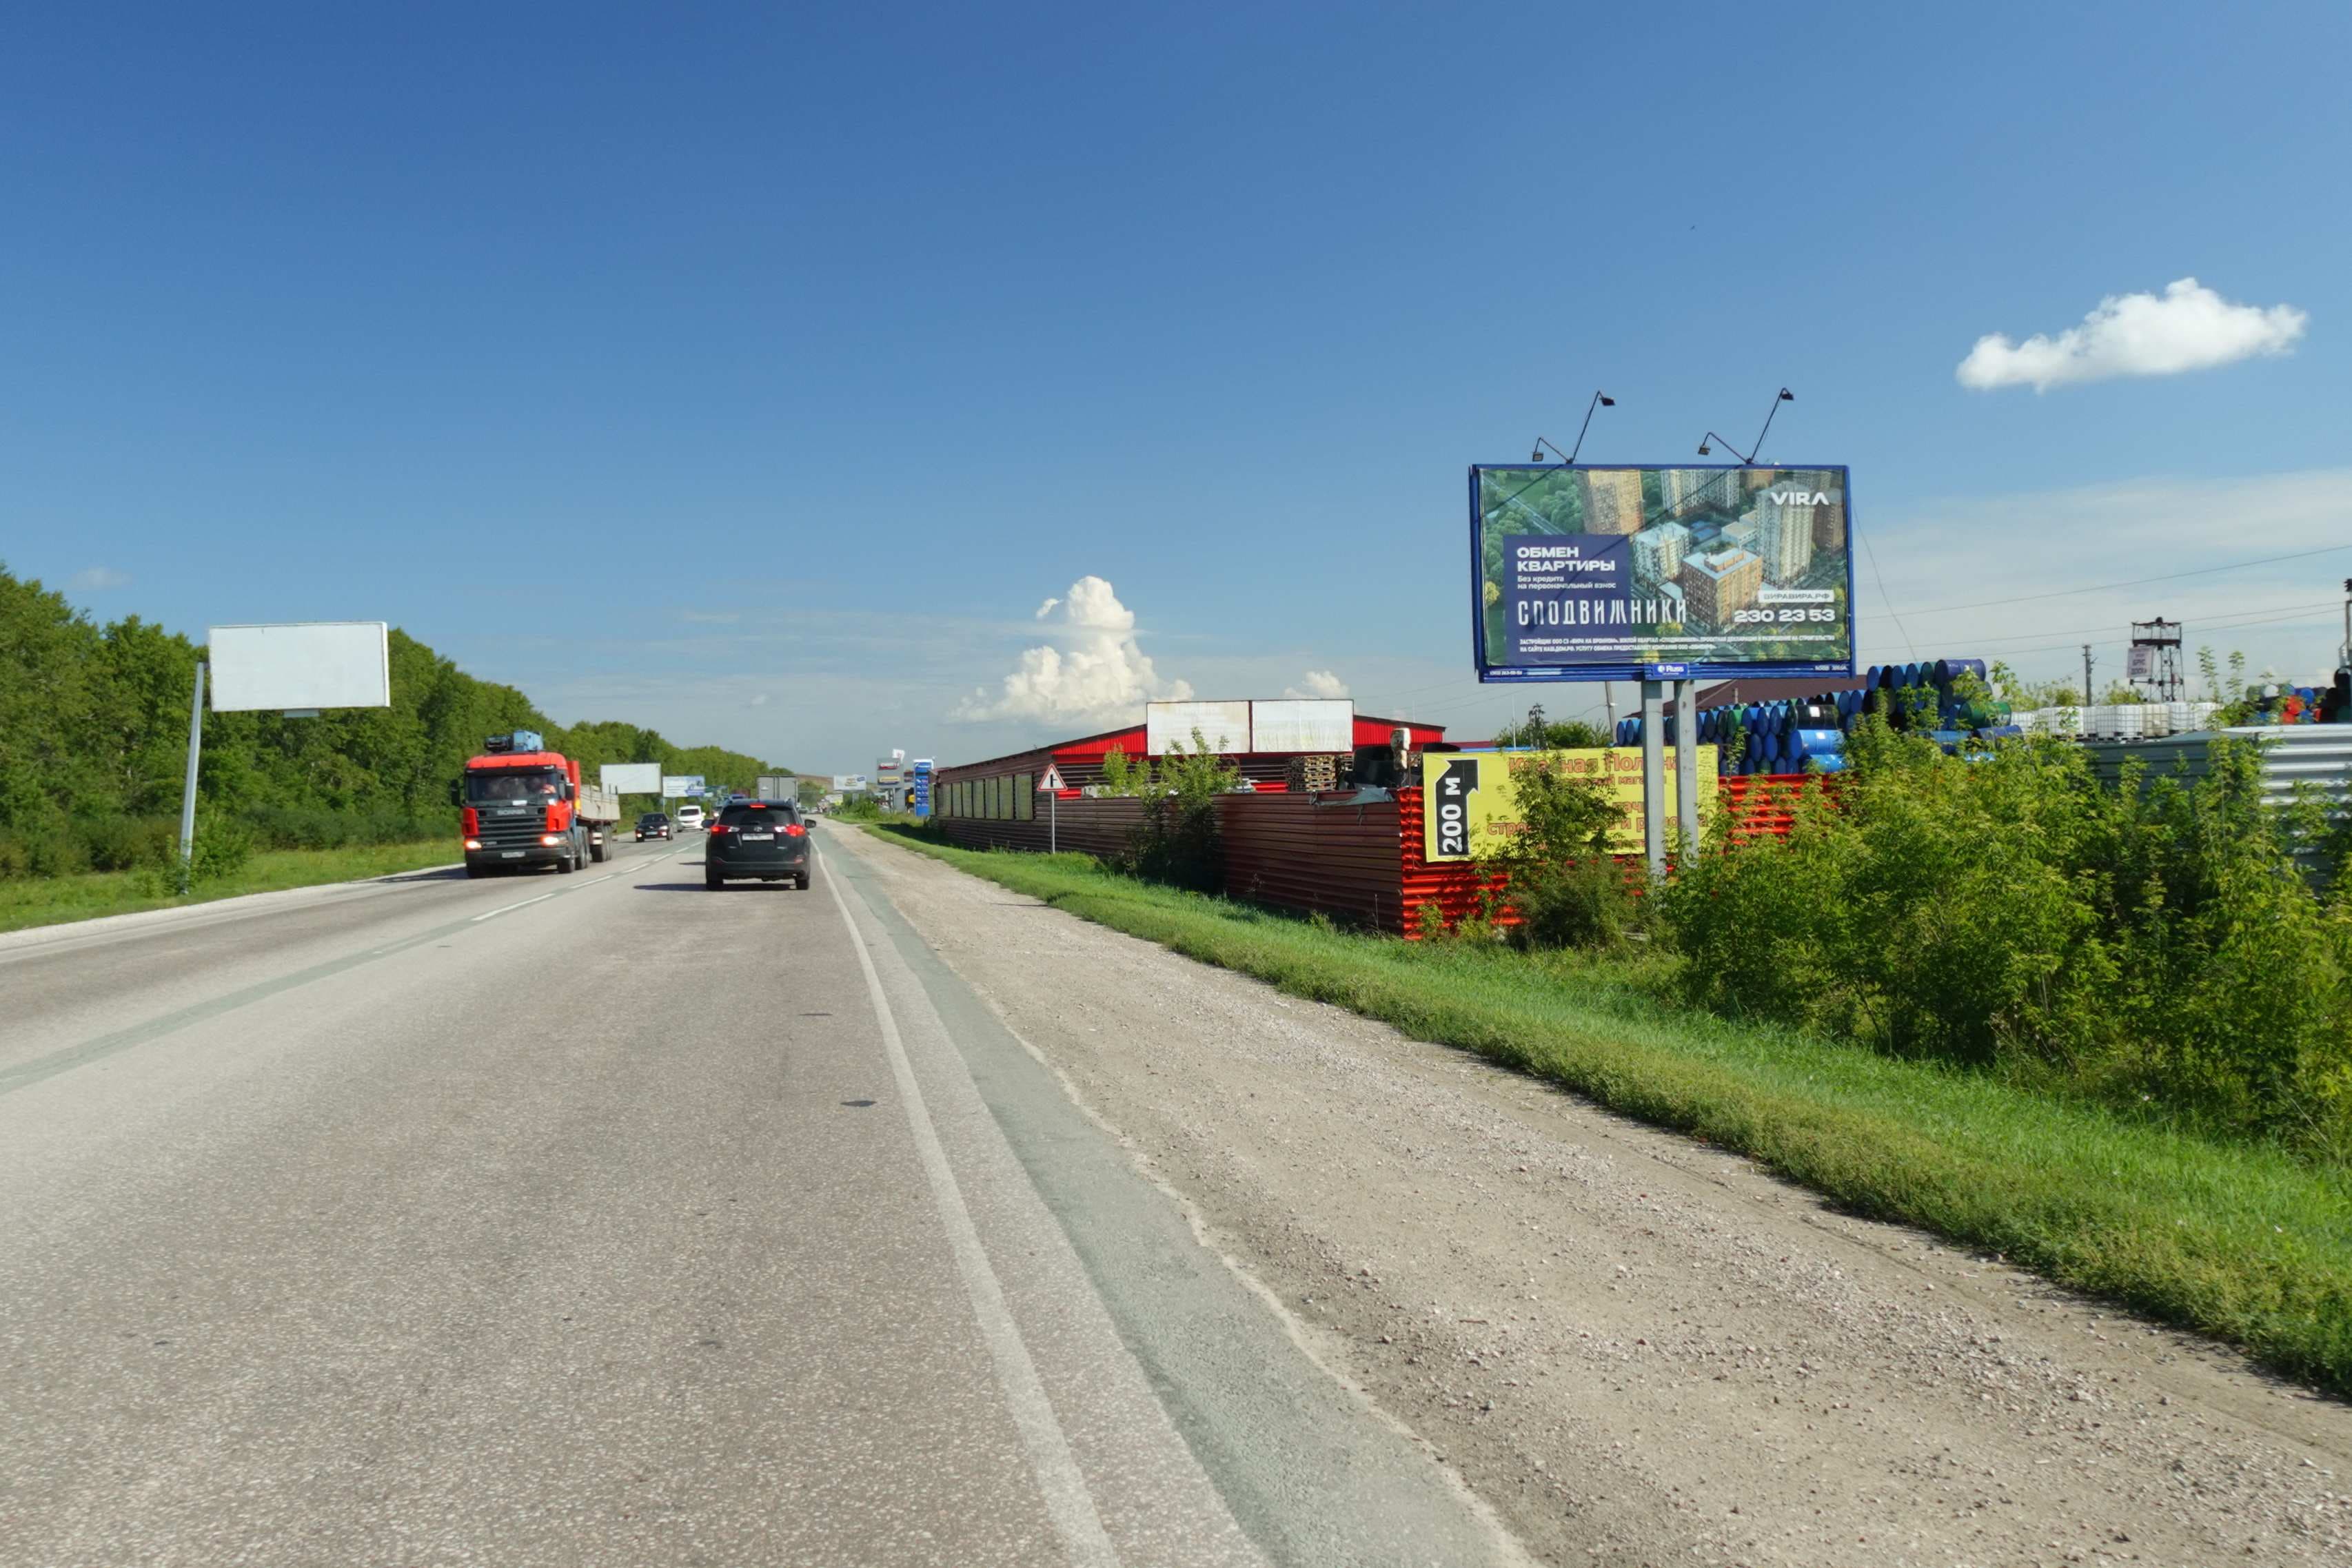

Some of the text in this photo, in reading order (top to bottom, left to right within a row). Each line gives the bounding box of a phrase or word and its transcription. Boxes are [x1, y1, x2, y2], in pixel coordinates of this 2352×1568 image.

[1770, 491, 1829, 505] VIRA
[1517, 547, 1579, 558] ОБМЕН
[1517, 560, 1615, 571] КВАРТИРЫ
[1518, 599, 1687, 625] СПОДВИЖНИКИ
[1734, 609, 1836, 623] 230 23 53
[1441, 804, 1463, 853] 200
